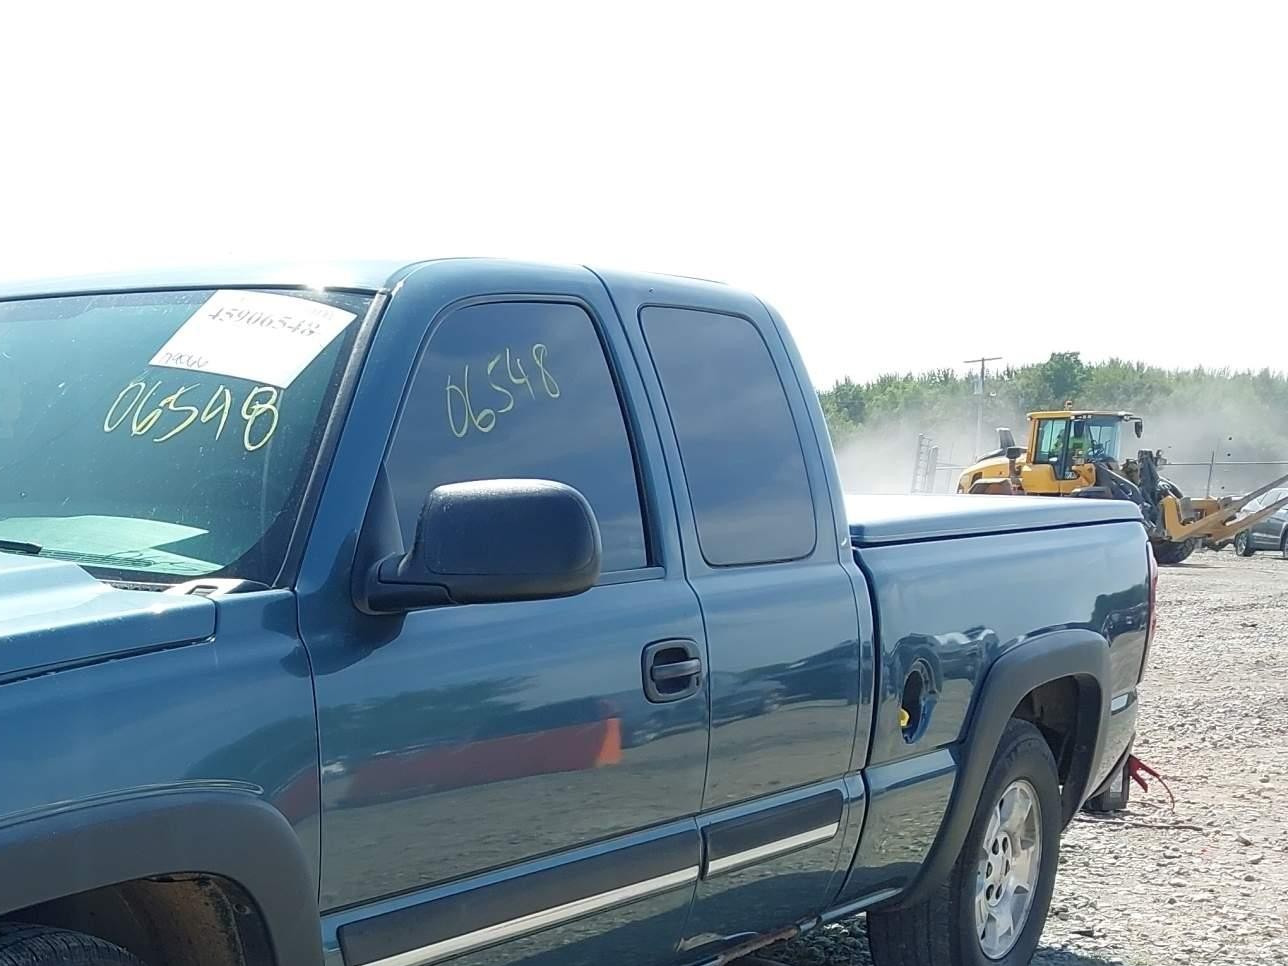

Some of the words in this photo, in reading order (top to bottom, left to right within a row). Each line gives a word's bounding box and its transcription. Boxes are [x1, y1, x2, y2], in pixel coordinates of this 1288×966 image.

[207, 306, 322, 338] 45906548
[102, 381, 280, 452] 06548
[445, 343, 560, 438] 06548
